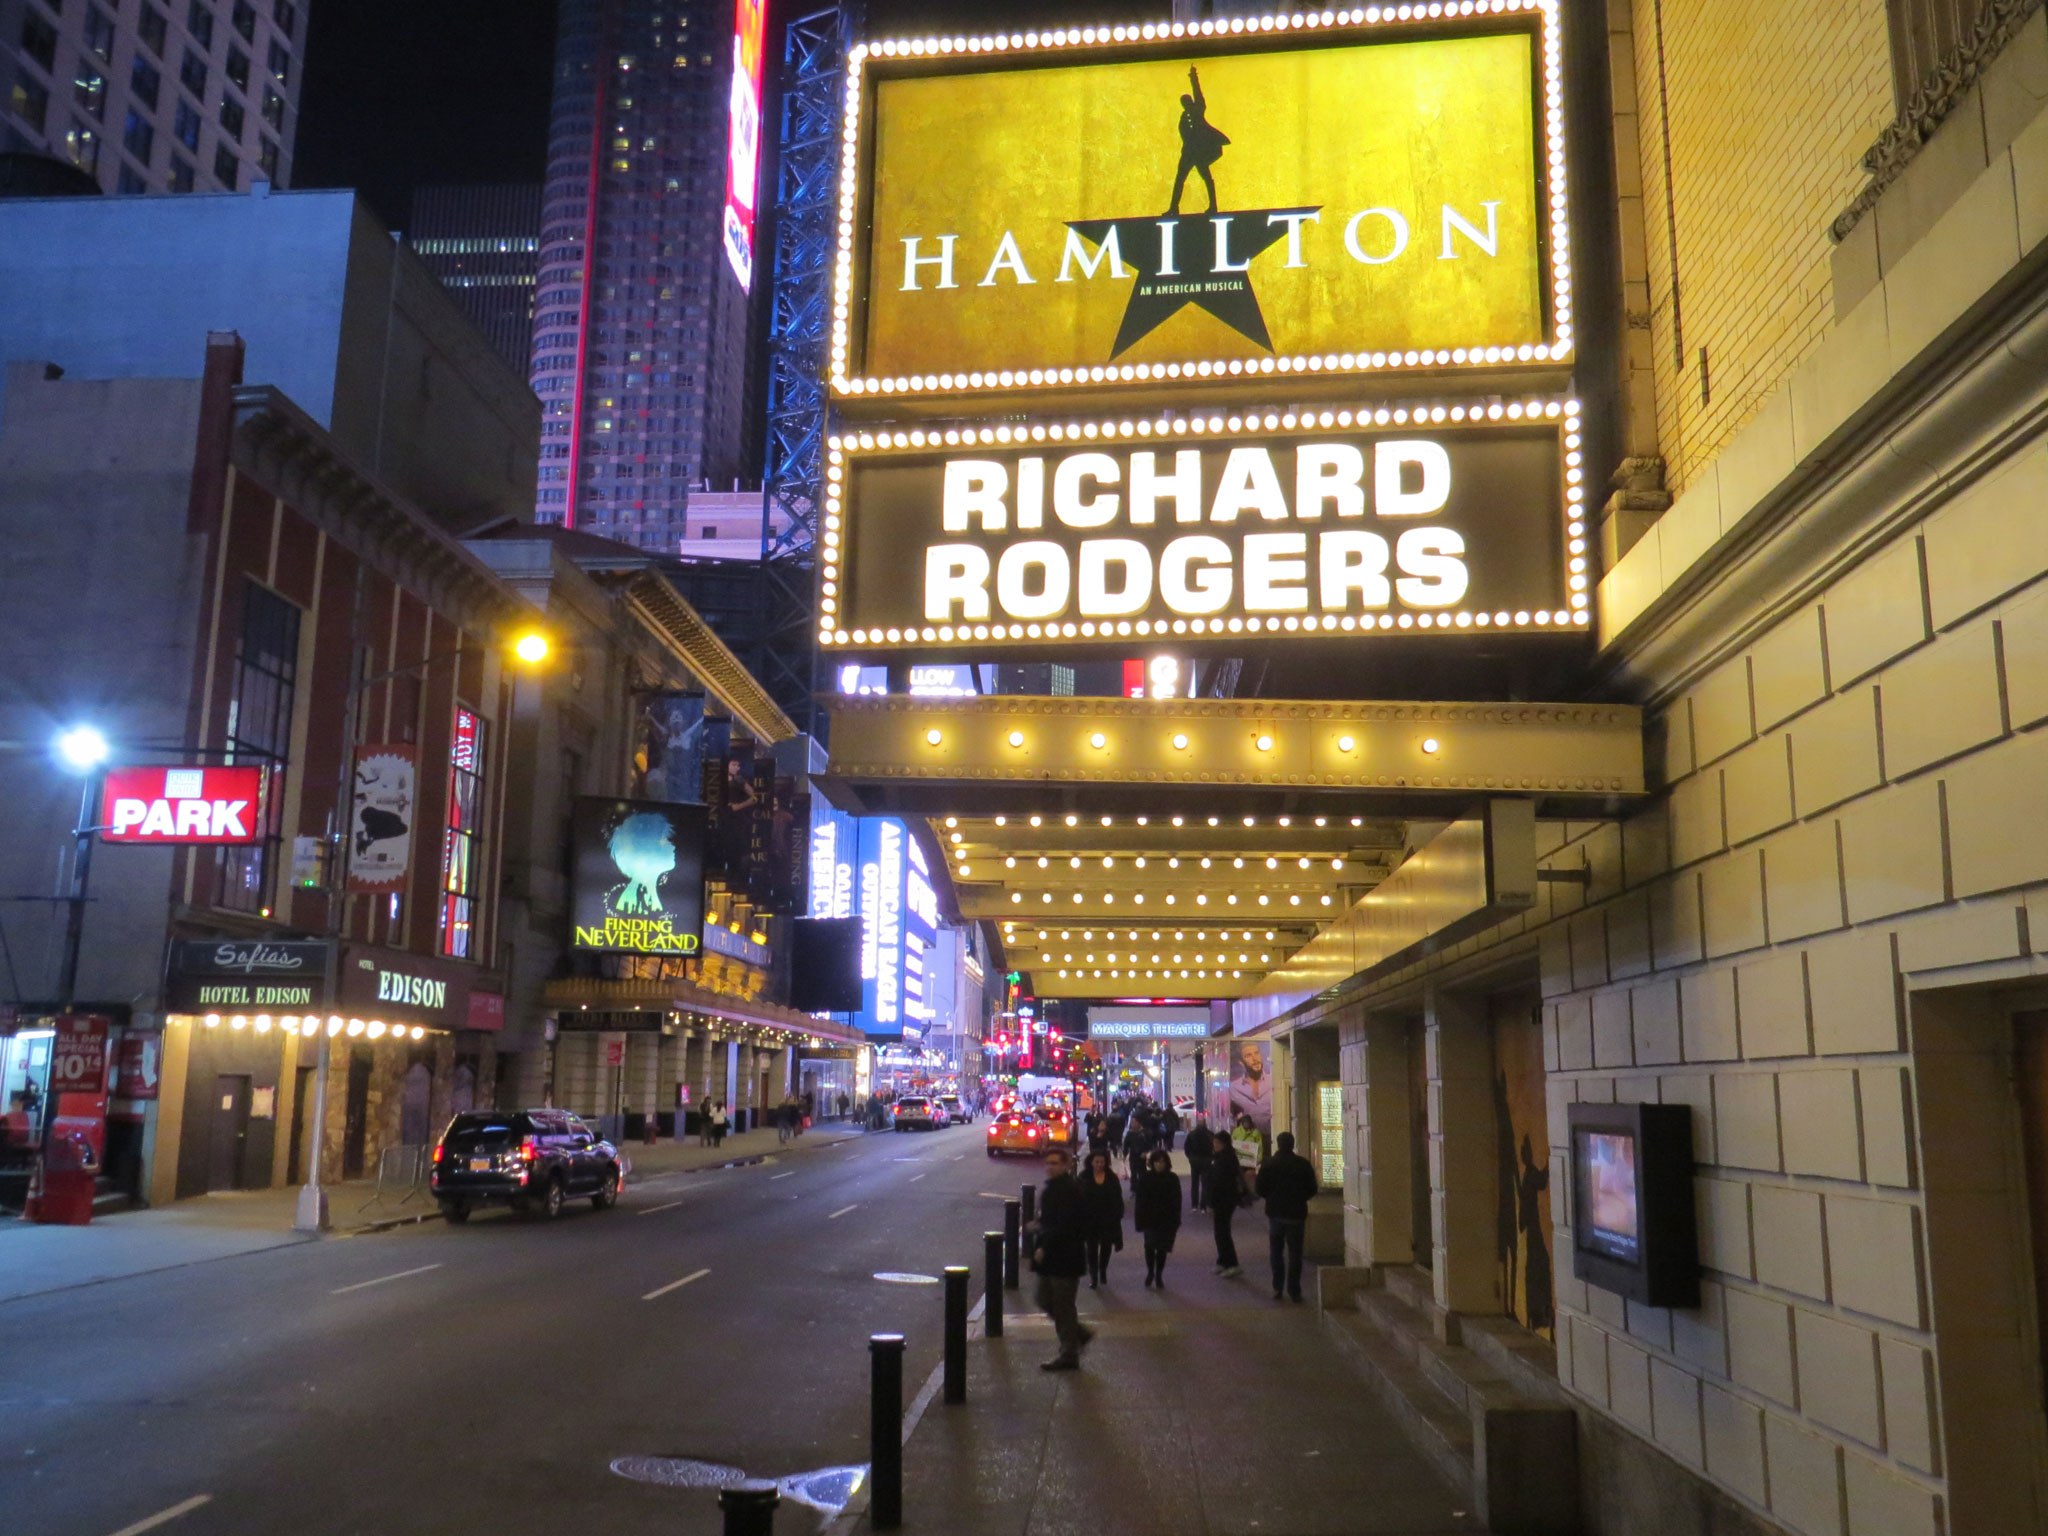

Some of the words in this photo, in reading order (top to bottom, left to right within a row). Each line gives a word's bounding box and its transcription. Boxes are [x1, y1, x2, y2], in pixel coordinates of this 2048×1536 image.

[899, 200, 1502, 292] HAMILTON
[1140, 286, 1152, 296] AN
[1155, 283, 1202, 295] AMERICAN
[1205, 281, 1244, 292] MUSICAL
[943, 439, 1452, 531] RICHARD
[924, 527, 1469, 622] RODGERS
[112, 798, 248, 837] PARK
[574, 925, 699, 953] NEVERLAND
[604, 916, 674, 934] FINDING
[213, 943, 303, 973] Sofia's
[358, 959, 375, 971] HOTEL
[199, 986, 250, 1004] HOTEL
[255, 986, 312, 1005] EDISON
[377, 970, 447, 1009] EDISON
[1092, 1023, 1151, 1038] MARQUIS
[1152, 1023, 1207, 1036] THEATRE
